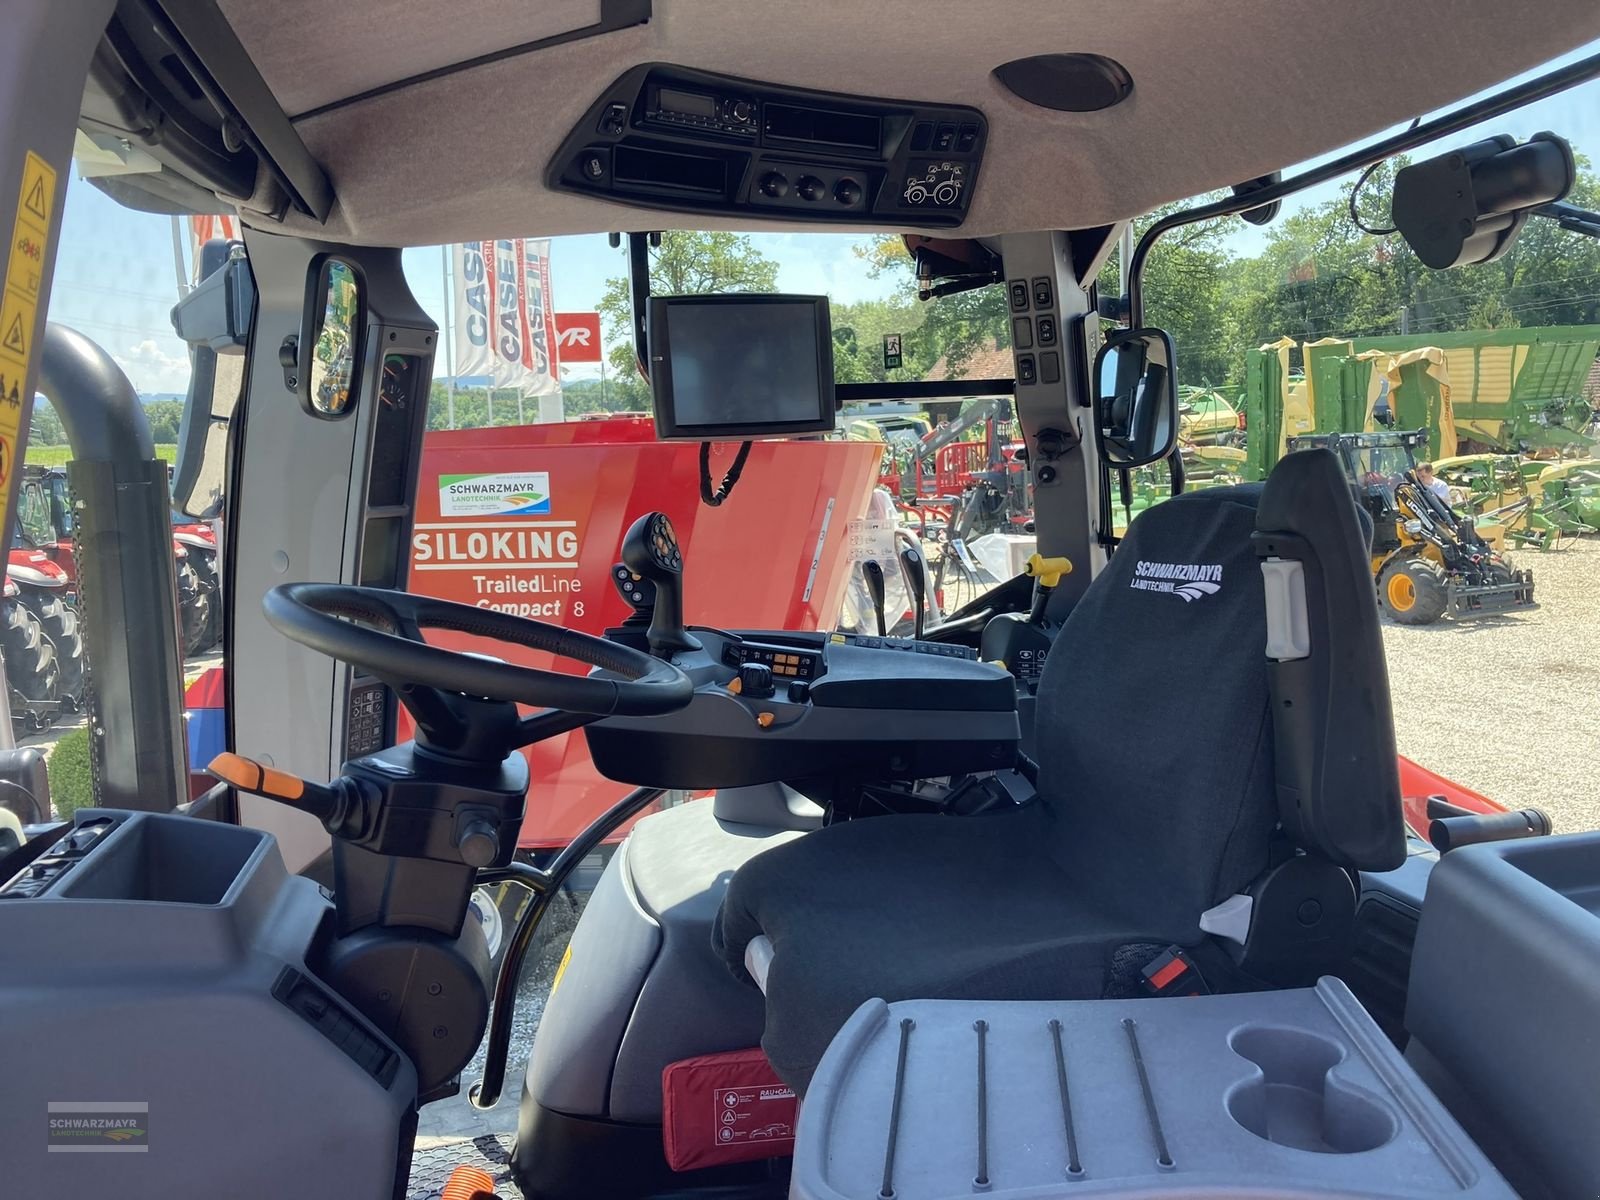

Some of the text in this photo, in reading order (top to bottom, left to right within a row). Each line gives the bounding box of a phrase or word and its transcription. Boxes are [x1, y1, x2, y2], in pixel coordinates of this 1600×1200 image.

[498, 257, 520, 362] CASE
[527, 286, 547, 374] CASE
[556, 327, 591, 347] YR
[449, 483, 534, 494] SCHWARZMAYR
[452, 495, 502, 503] LANDTECHNIK
[820, 530, 826, 541] 3
[413, 531, 578, 561] SILOKING
[812, 559, 818, 570] 2
[1135, 560, 1222, 581] SCHWARZMAYR
[472, 575, 582, 594] TrailedLine
[1130, 578, 1175, 593] LANDTECHNIK
[573, 601, 585, 617] 8
